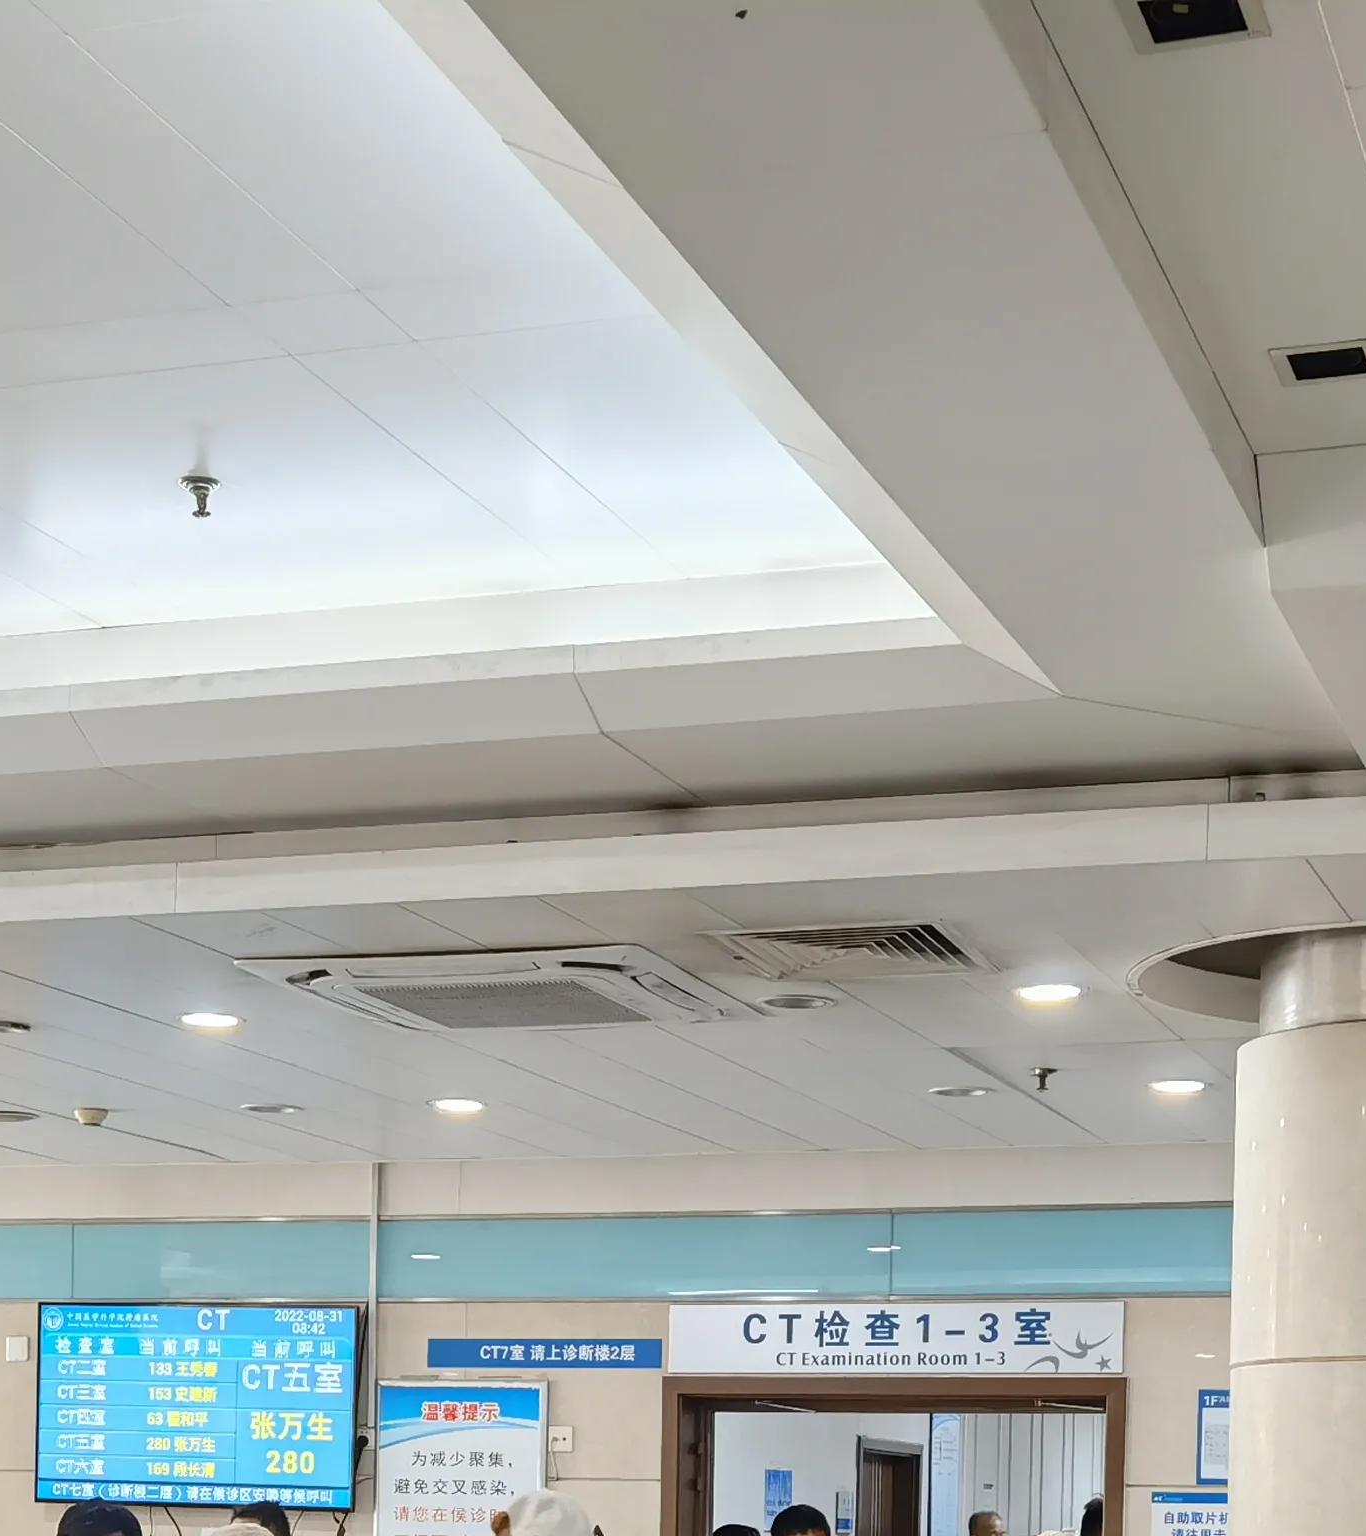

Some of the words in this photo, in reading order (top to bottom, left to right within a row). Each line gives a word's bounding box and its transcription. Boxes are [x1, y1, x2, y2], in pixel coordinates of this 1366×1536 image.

[197, 1309, 230, 1331] CT
[480, 1345, 525, 1361] CT7室
[530, 1344, 635, 1362] 请上诊断楼2层
[775, 1352, 799, 1366] CT
[802, 1352, 912, 1366] Examination
[917, 1352, 968, 1366] Room
[241, 1362, 343, 1394] CT五室
[421, 1401, 500, 1422] 温馨提示
[250, 1411, 333, 1441] 张万生
[265, 1450, 315, 1474] 280
